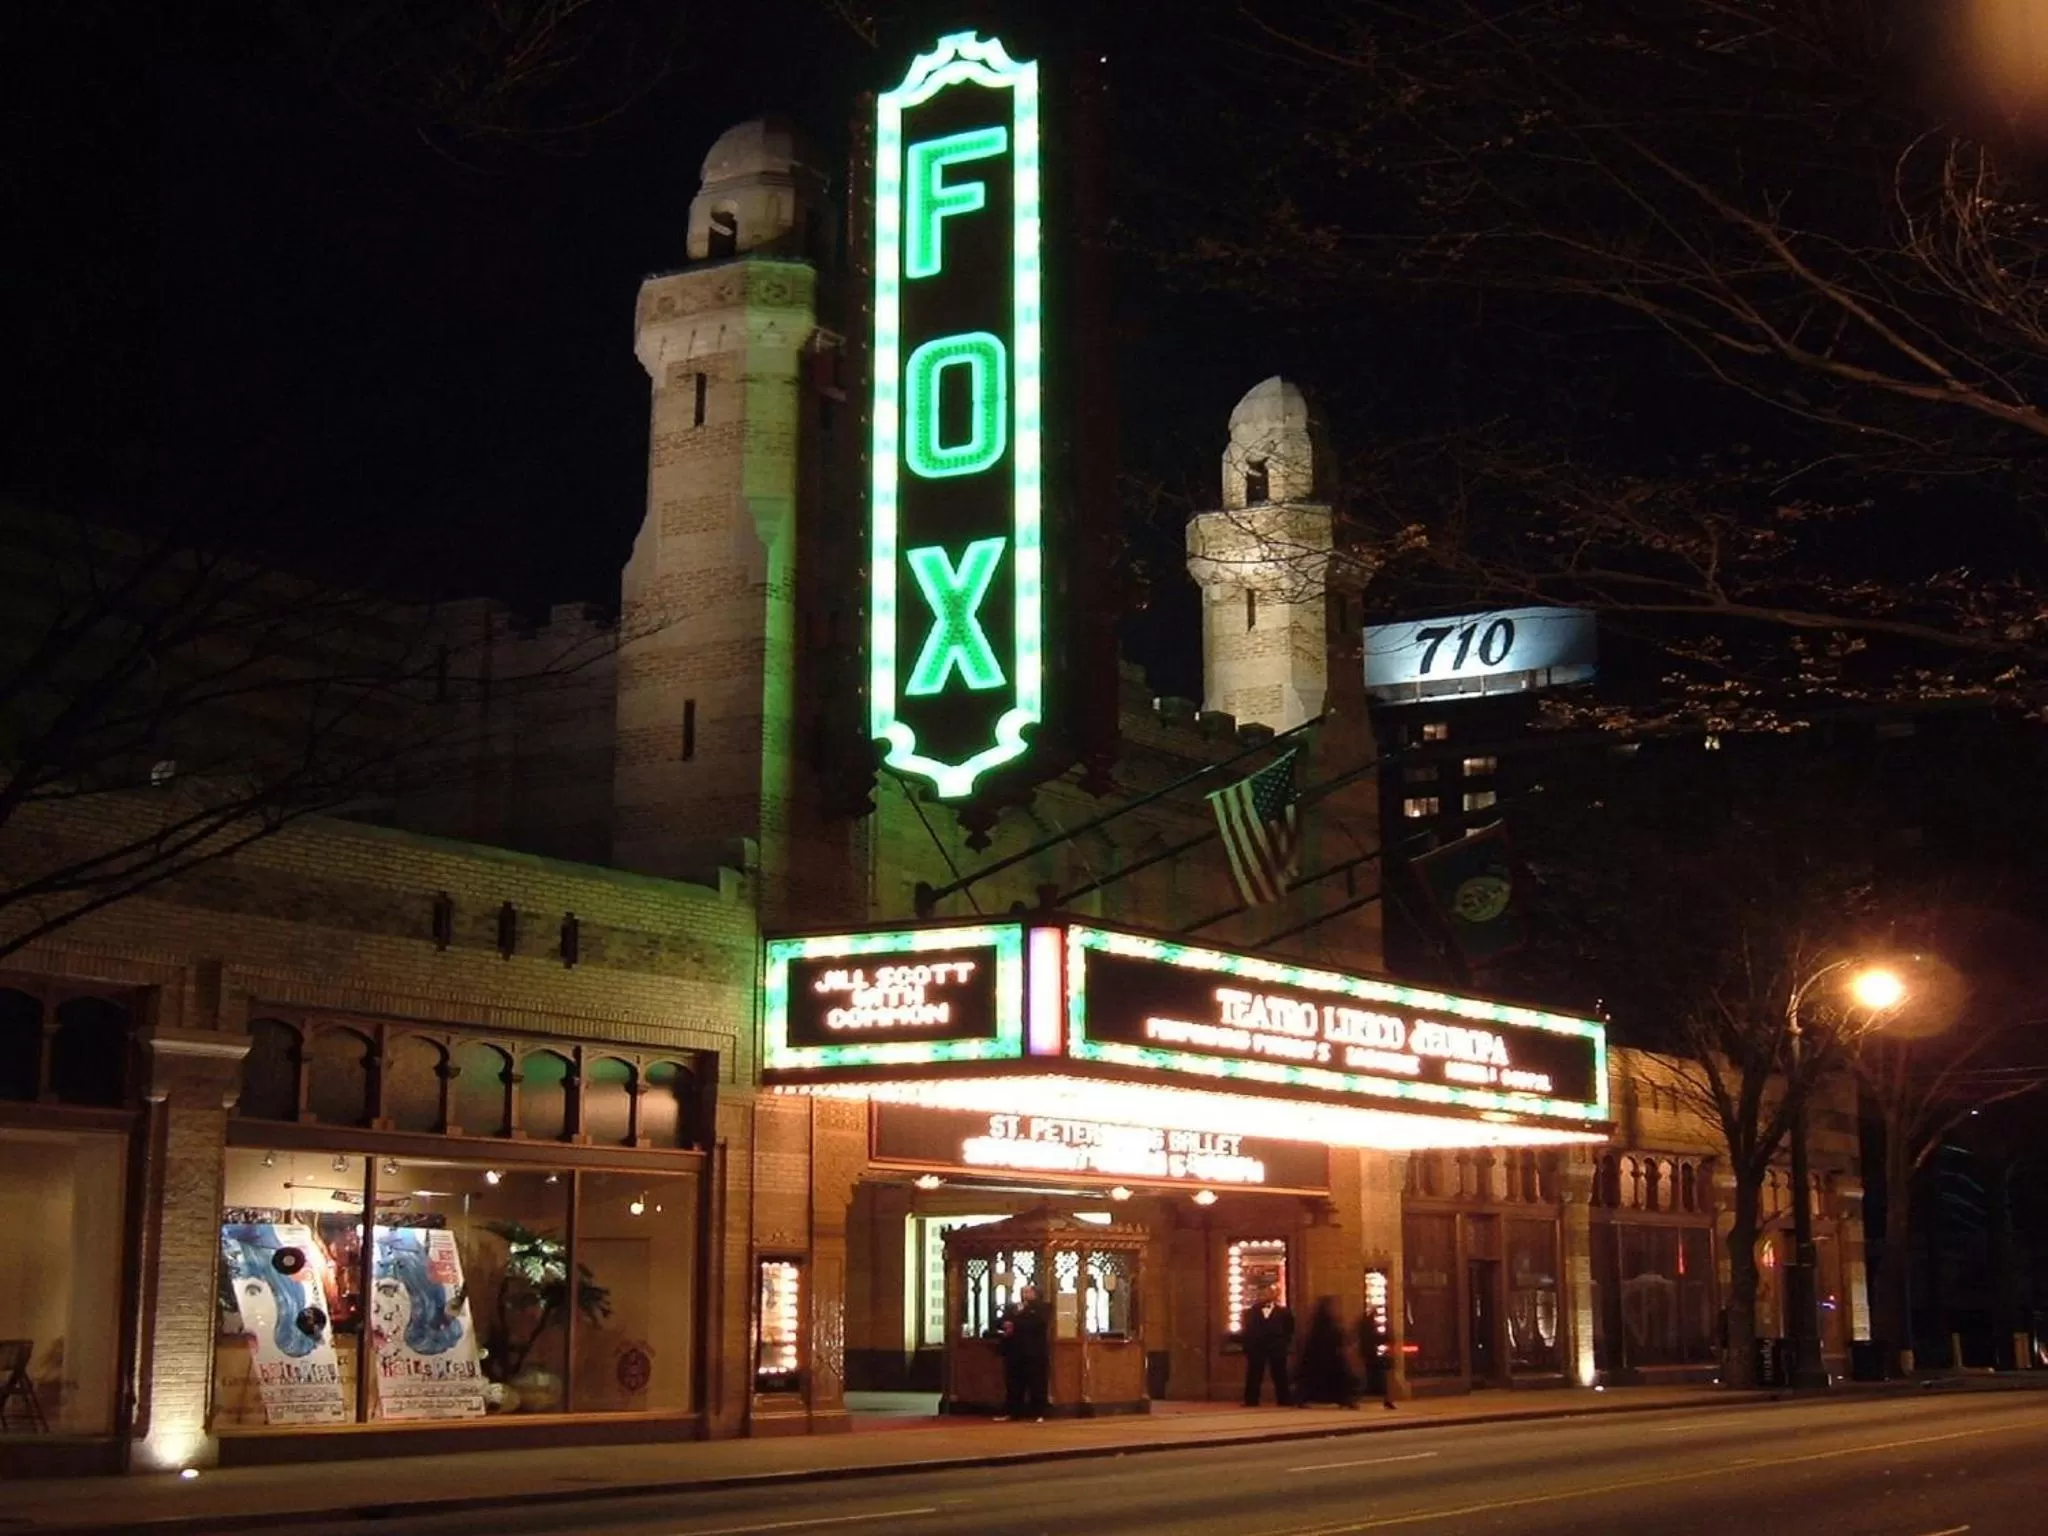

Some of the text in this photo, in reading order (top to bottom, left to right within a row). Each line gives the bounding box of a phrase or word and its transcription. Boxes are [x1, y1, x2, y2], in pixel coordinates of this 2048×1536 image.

[905, 125, 1008, 696] FOX
[1416, 618, 1515, 674] 710
[815, 962, 976, 992] JILL SCOTT
[852, 986, 925, 1008] WITH
[827, 1002, 949, 1029] COMMON
[1216, 988, 1318, 1036] TEATRO
[989, 1115, 1025, 1141] ST.
[1170, 1129, 1242, 1157] BALLET
